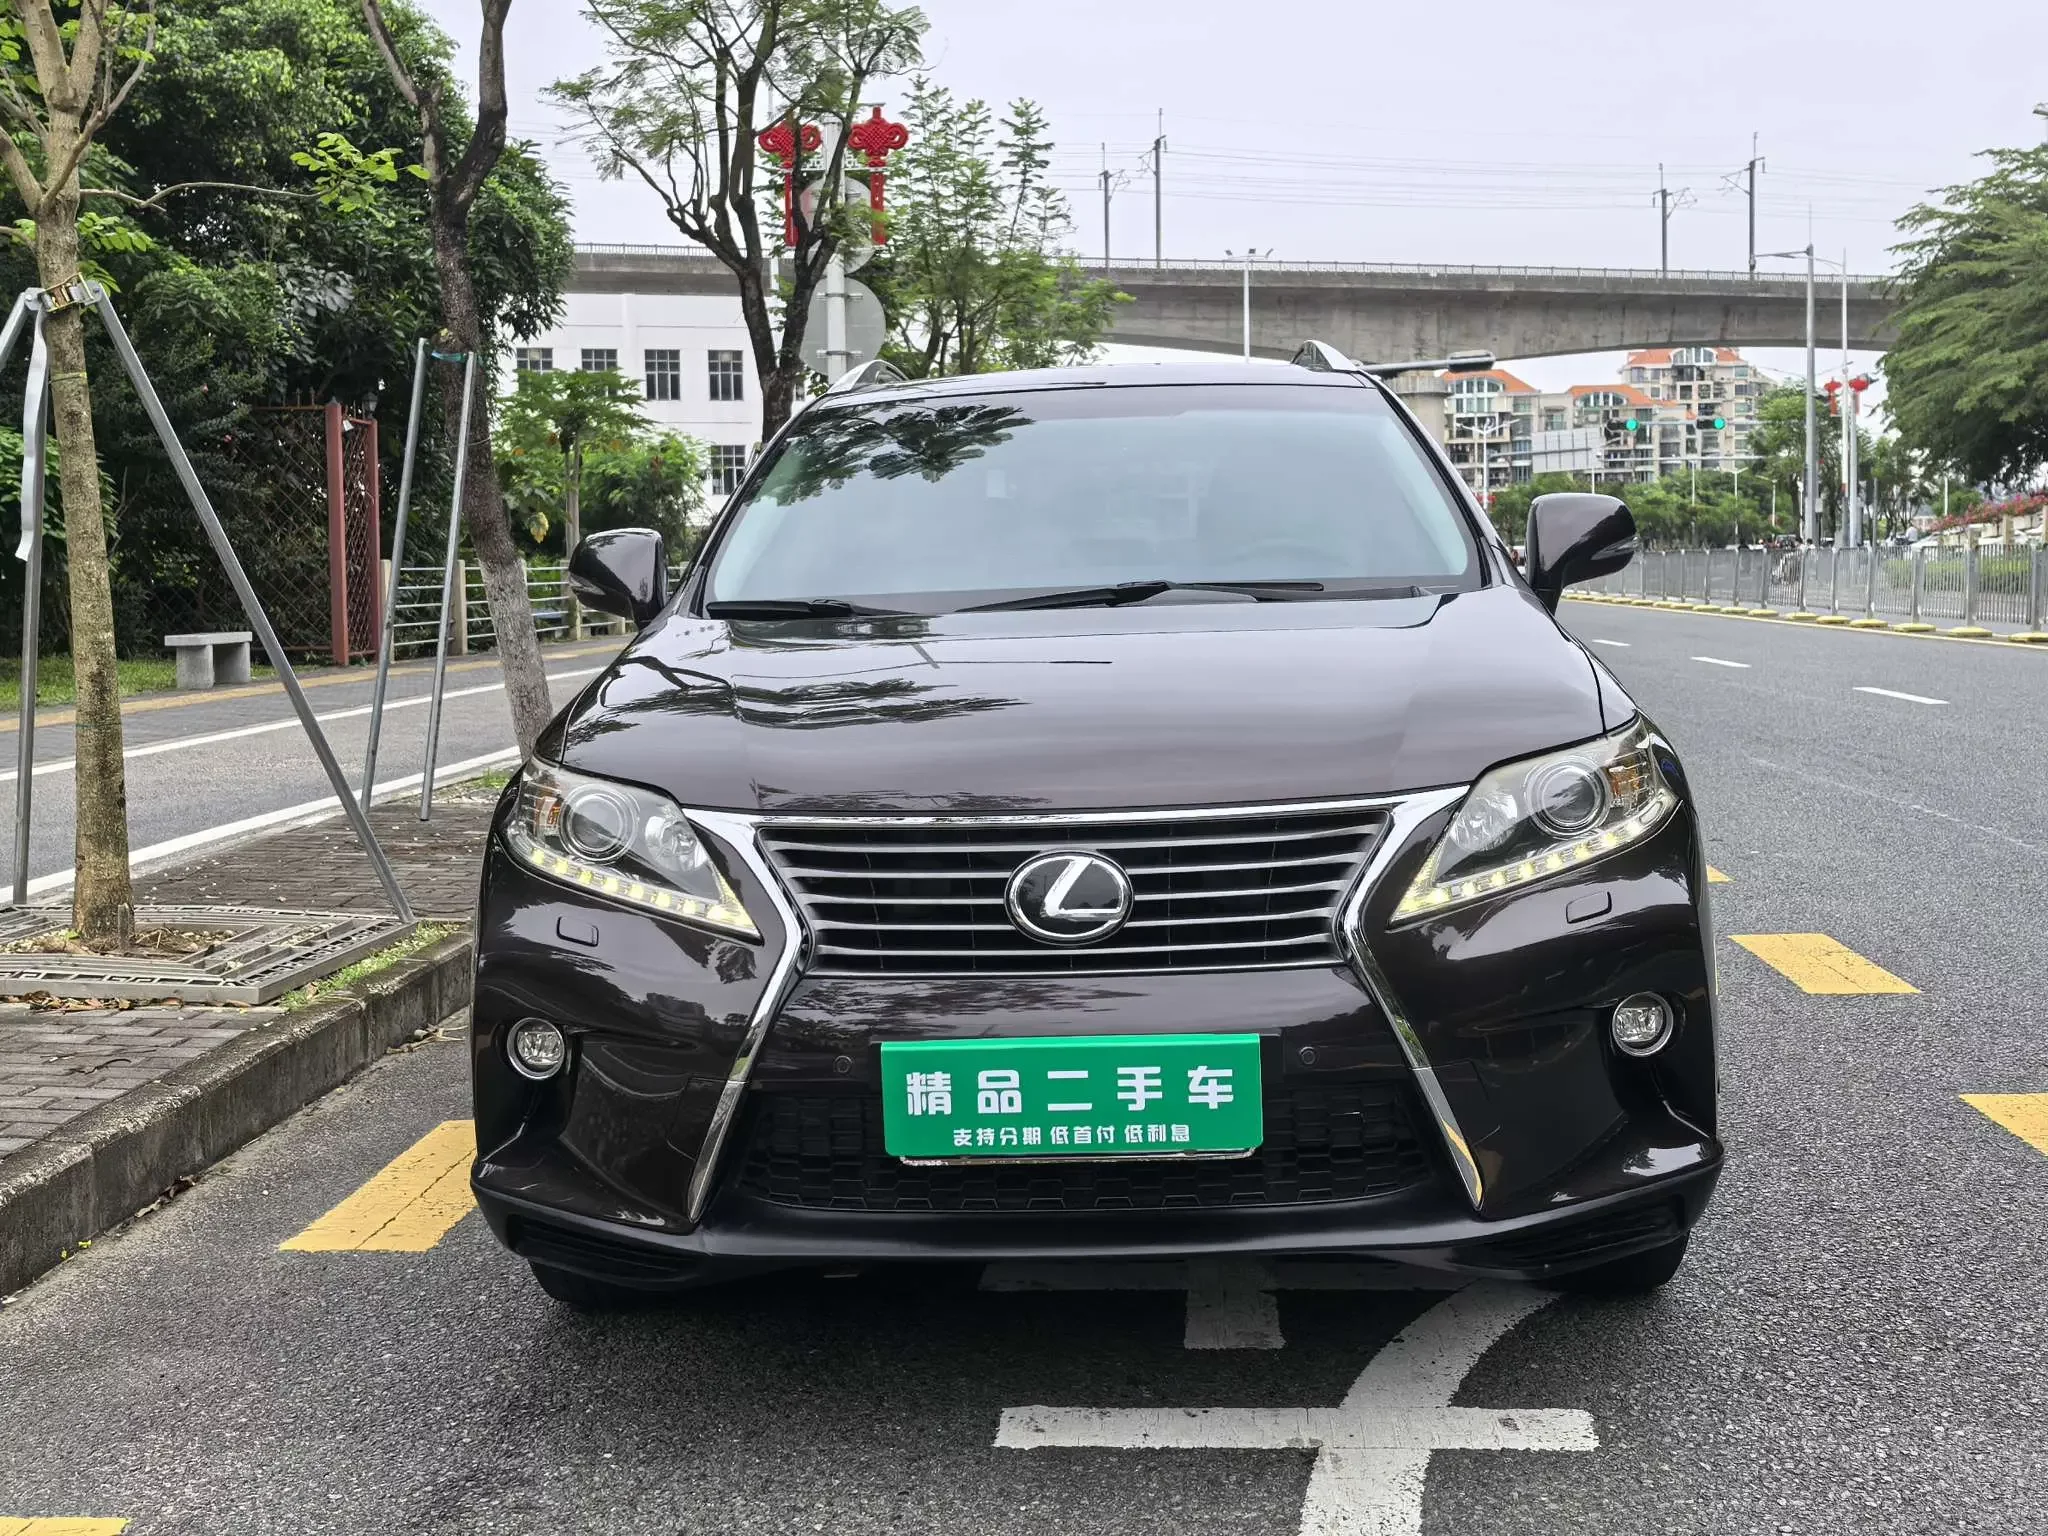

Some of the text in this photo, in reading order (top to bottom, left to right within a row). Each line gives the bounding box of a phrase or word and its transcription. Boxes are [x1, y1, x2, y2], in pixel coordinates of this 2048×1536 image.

[905, 1065, 1235, 1116] 精品二手车
[952, 1123, 1192, 1147] 支持分期 低首付 低利息
